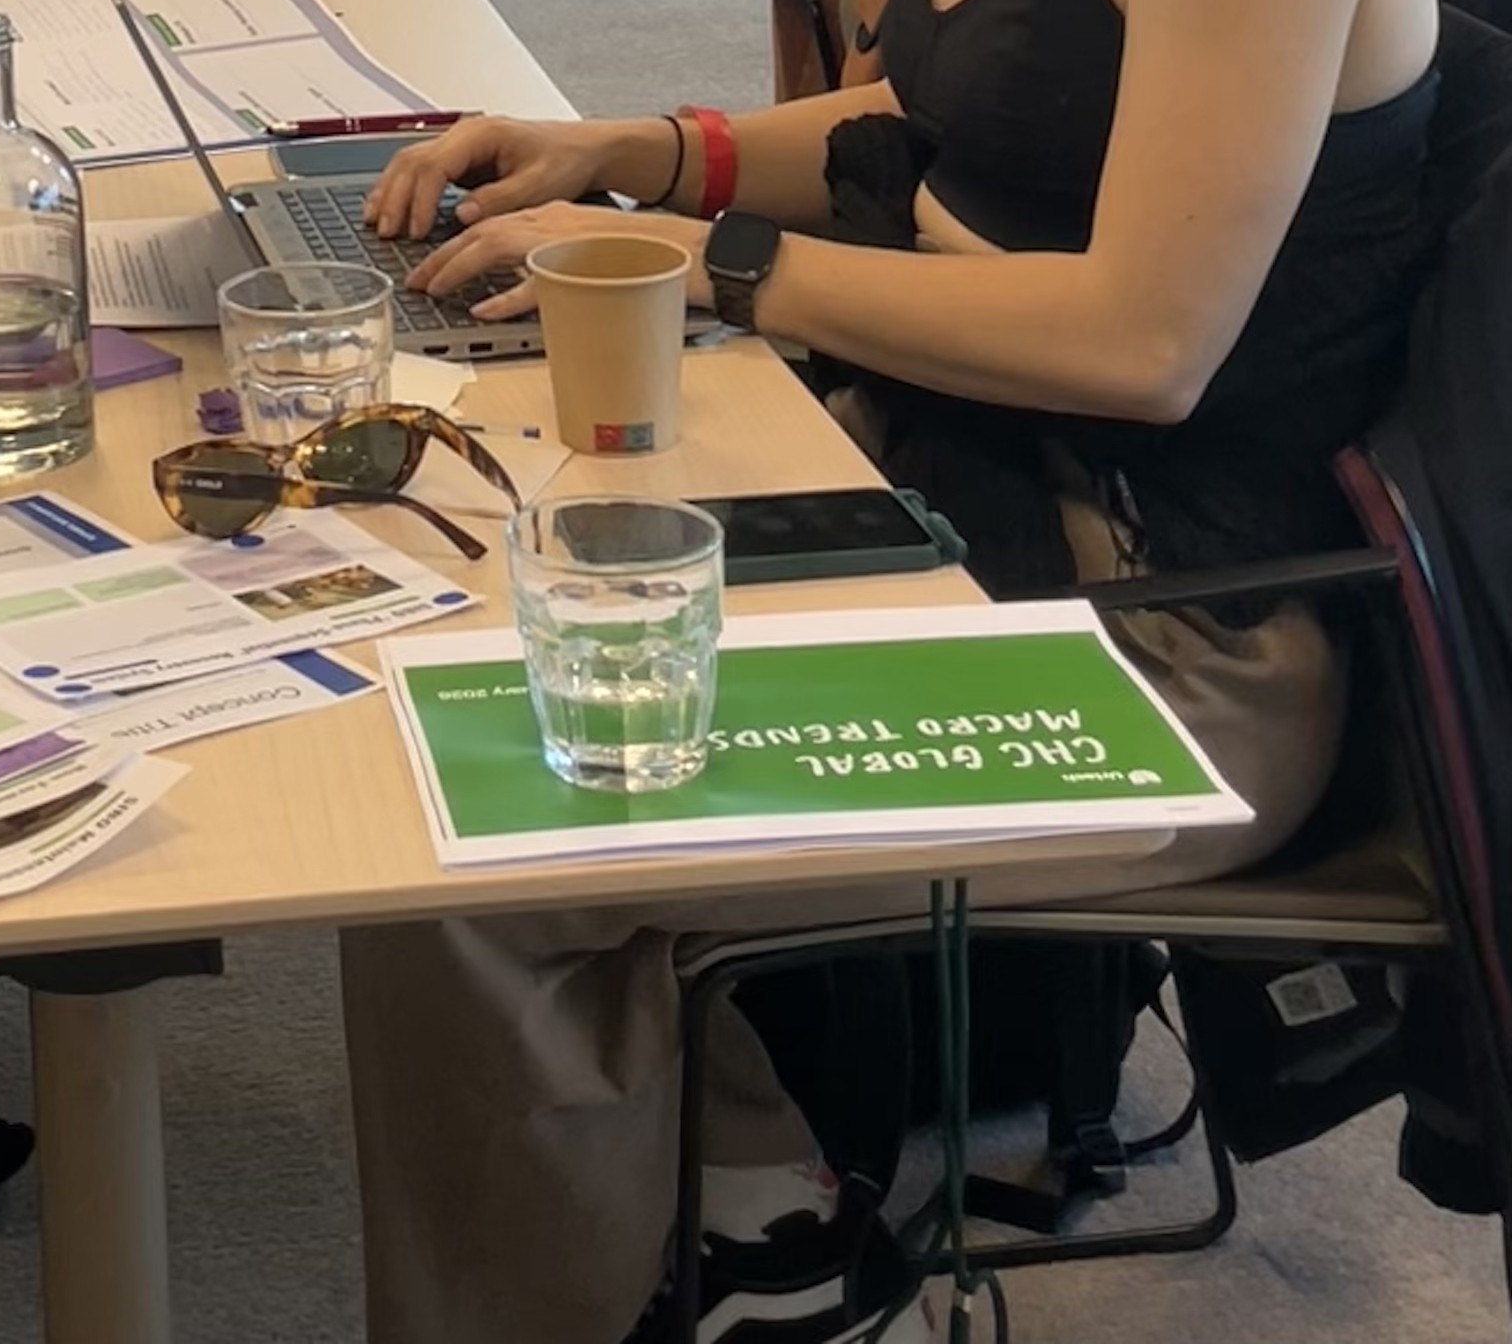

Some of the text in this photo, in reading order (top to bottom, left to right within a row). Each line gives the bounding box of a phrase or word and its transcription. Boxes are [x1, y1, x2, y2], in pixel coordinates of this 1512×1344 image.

[182, 684, 302, 724] Concept
[705, 708, 1083, 752] MACRO TRENDS
[794, 735, 1108, 778] CHC GLOBAL
